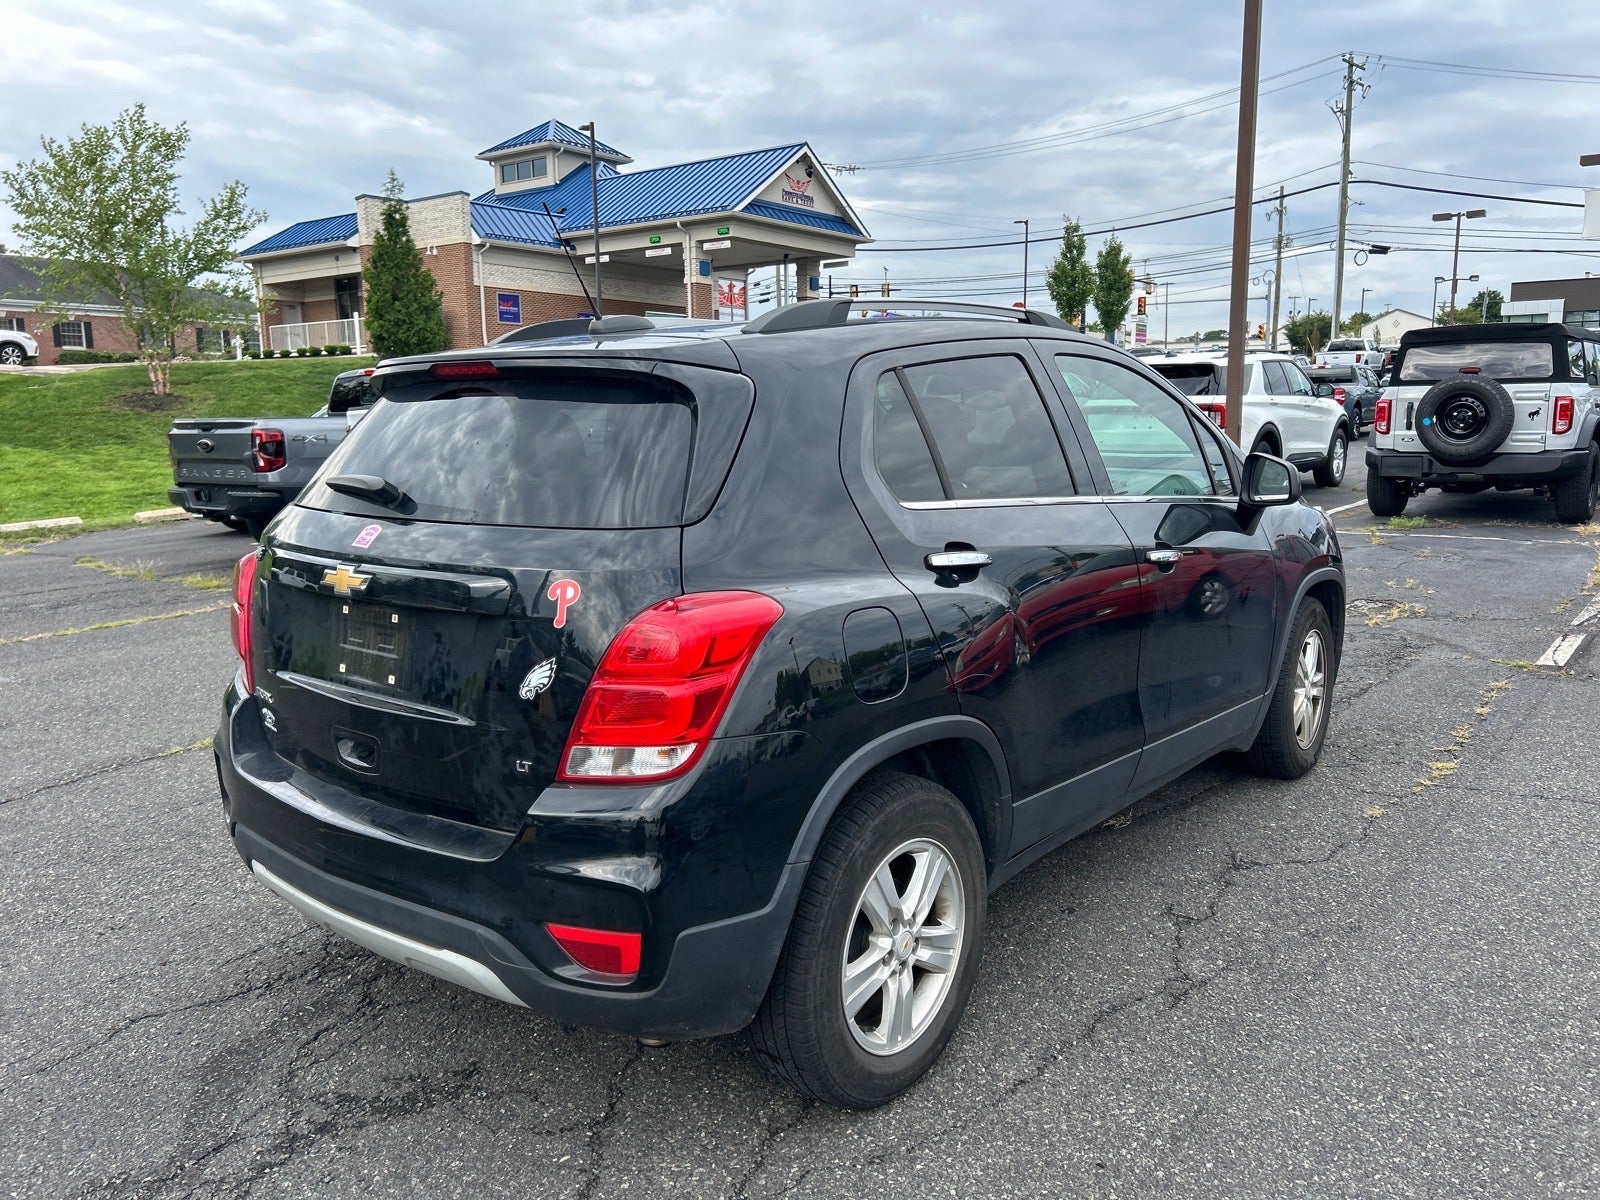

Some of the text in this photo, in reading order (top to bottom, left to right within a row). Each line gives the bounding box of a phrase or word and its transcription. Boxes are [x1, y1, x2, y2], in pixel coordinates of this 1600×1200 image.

[180, 468, 248, 478] RANGER
[547, 579, 581, 628] P
[516, 760, 532, 773] LT
